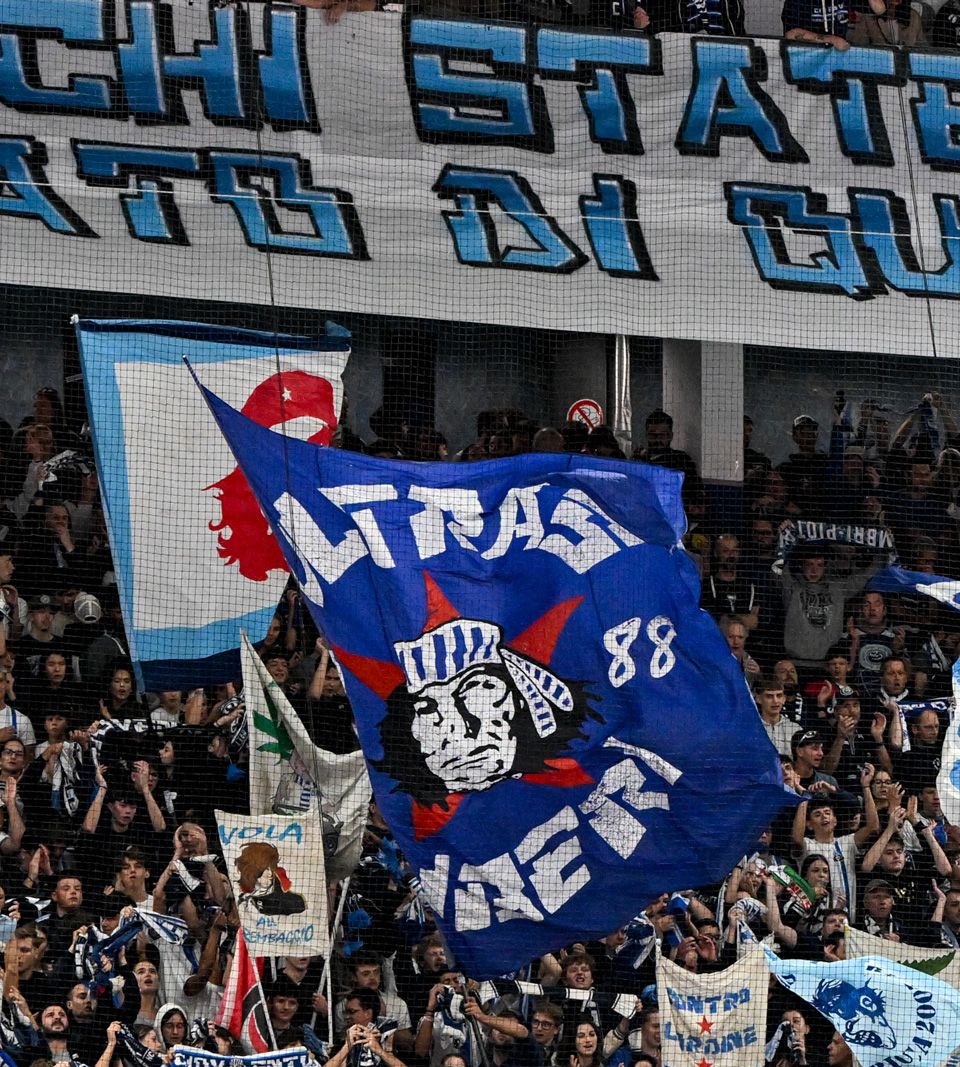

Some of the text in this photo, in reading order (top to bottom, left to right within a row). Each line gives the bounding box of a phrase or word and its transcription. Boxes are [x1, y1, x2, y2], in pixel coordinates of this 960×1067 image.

[432, 162, 661, 281] DI
[603, 614, 677, 689] 88
[218, 821, 304, 846] VOLA
